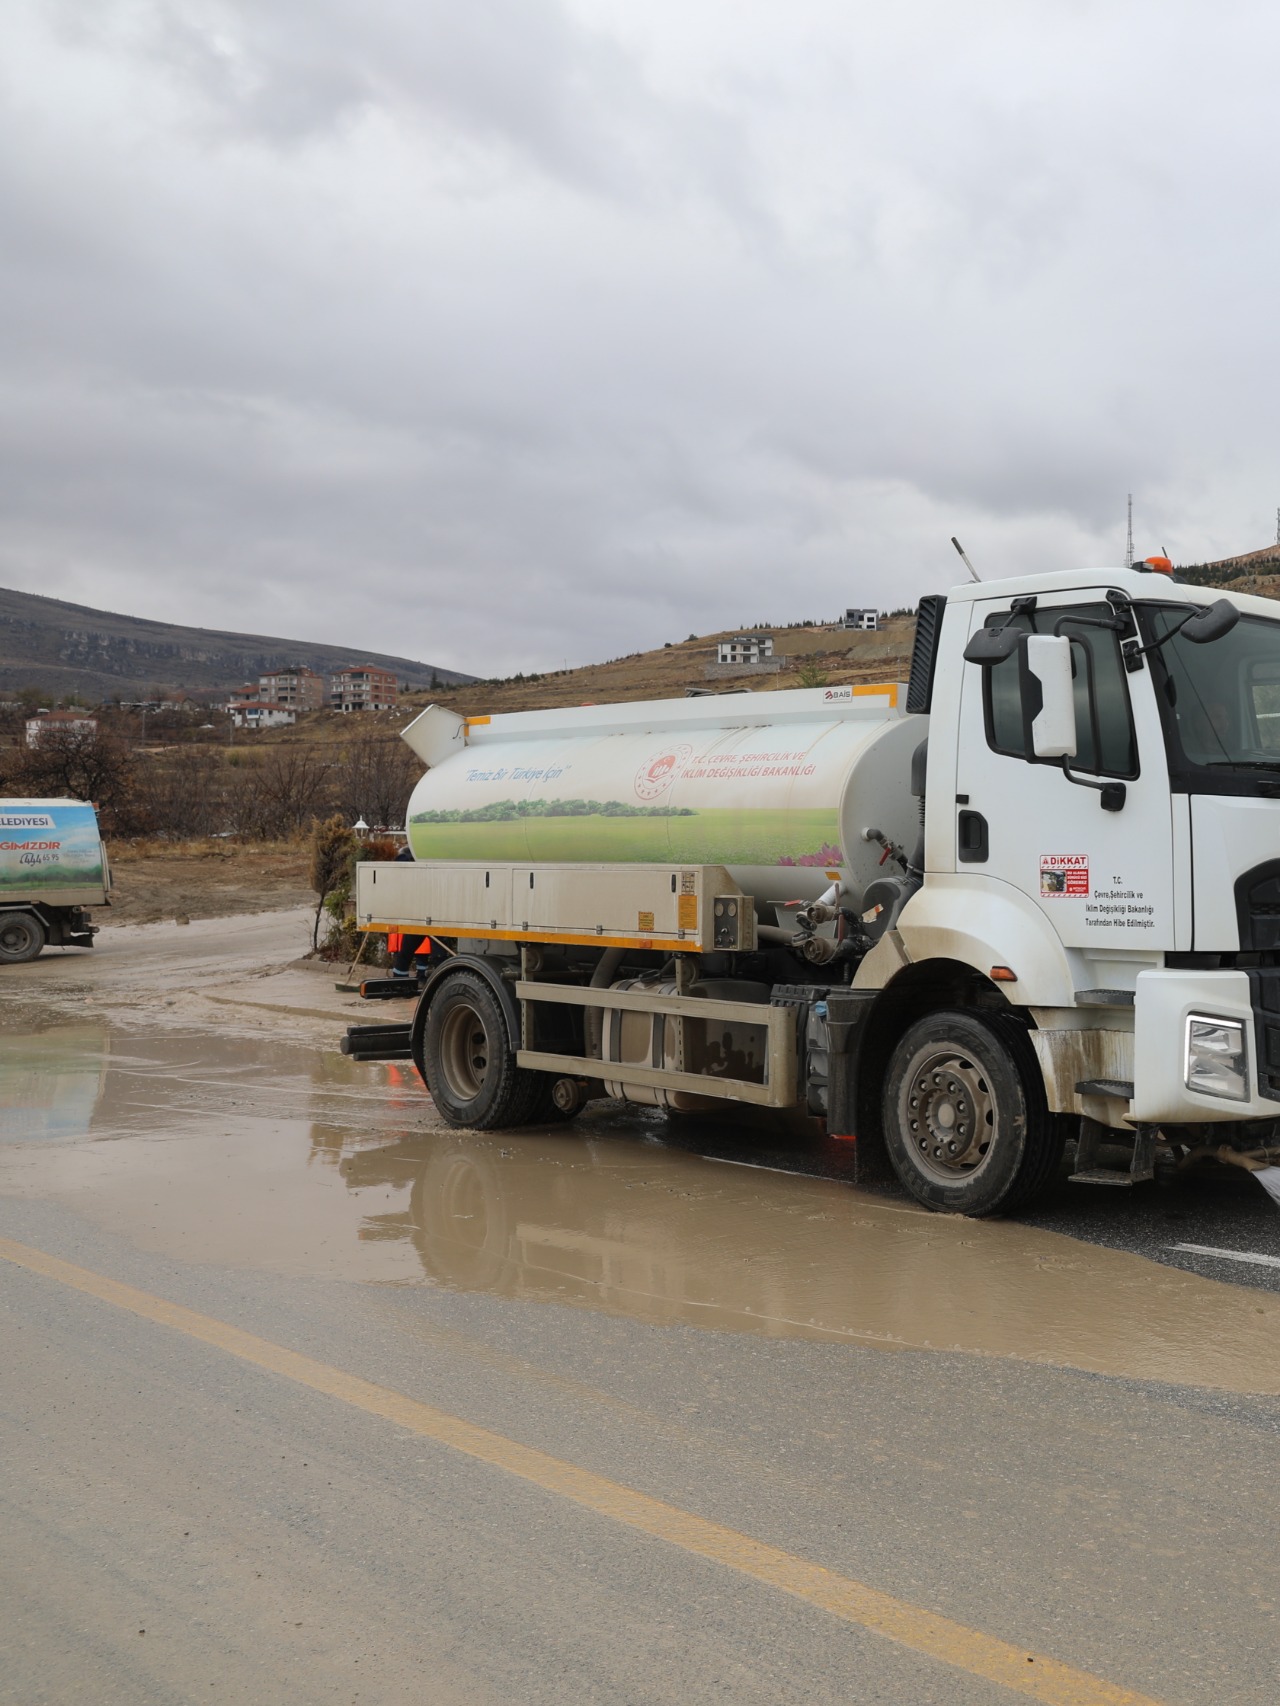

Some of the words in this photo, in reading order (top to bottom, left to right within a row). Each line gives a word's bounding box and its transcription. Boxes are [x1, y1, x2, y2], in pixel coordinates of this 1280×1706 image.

[739, 752, 792, 765] ŞEHİRCİLİK
[792, 752, 806, 761] VE
[492, 767, 508, 781] Bir
[508, 766, 543, 783] Türkiye
[681, 766, 706, 779] İKLİM
[706, 765, 763, 780] DEĞİŞİKLİĞİ
[762, 763, 816, 777] BAKANLIĞI
[42, 853, 50, 861] 65
[1050, 856, 1086, 865] DİKKAT
[1113, 876, 1123, 885] T.C.
[1099, 905, 1126, 915] Değişikliği
[1127, 905, 1154, 915] Bakanlığı
[1085, 918, 1112, 926] Tarafından
[1113, 918, 1126, 926] Hibe
[1127, 919, 1155, 929] Edilmiştir.
